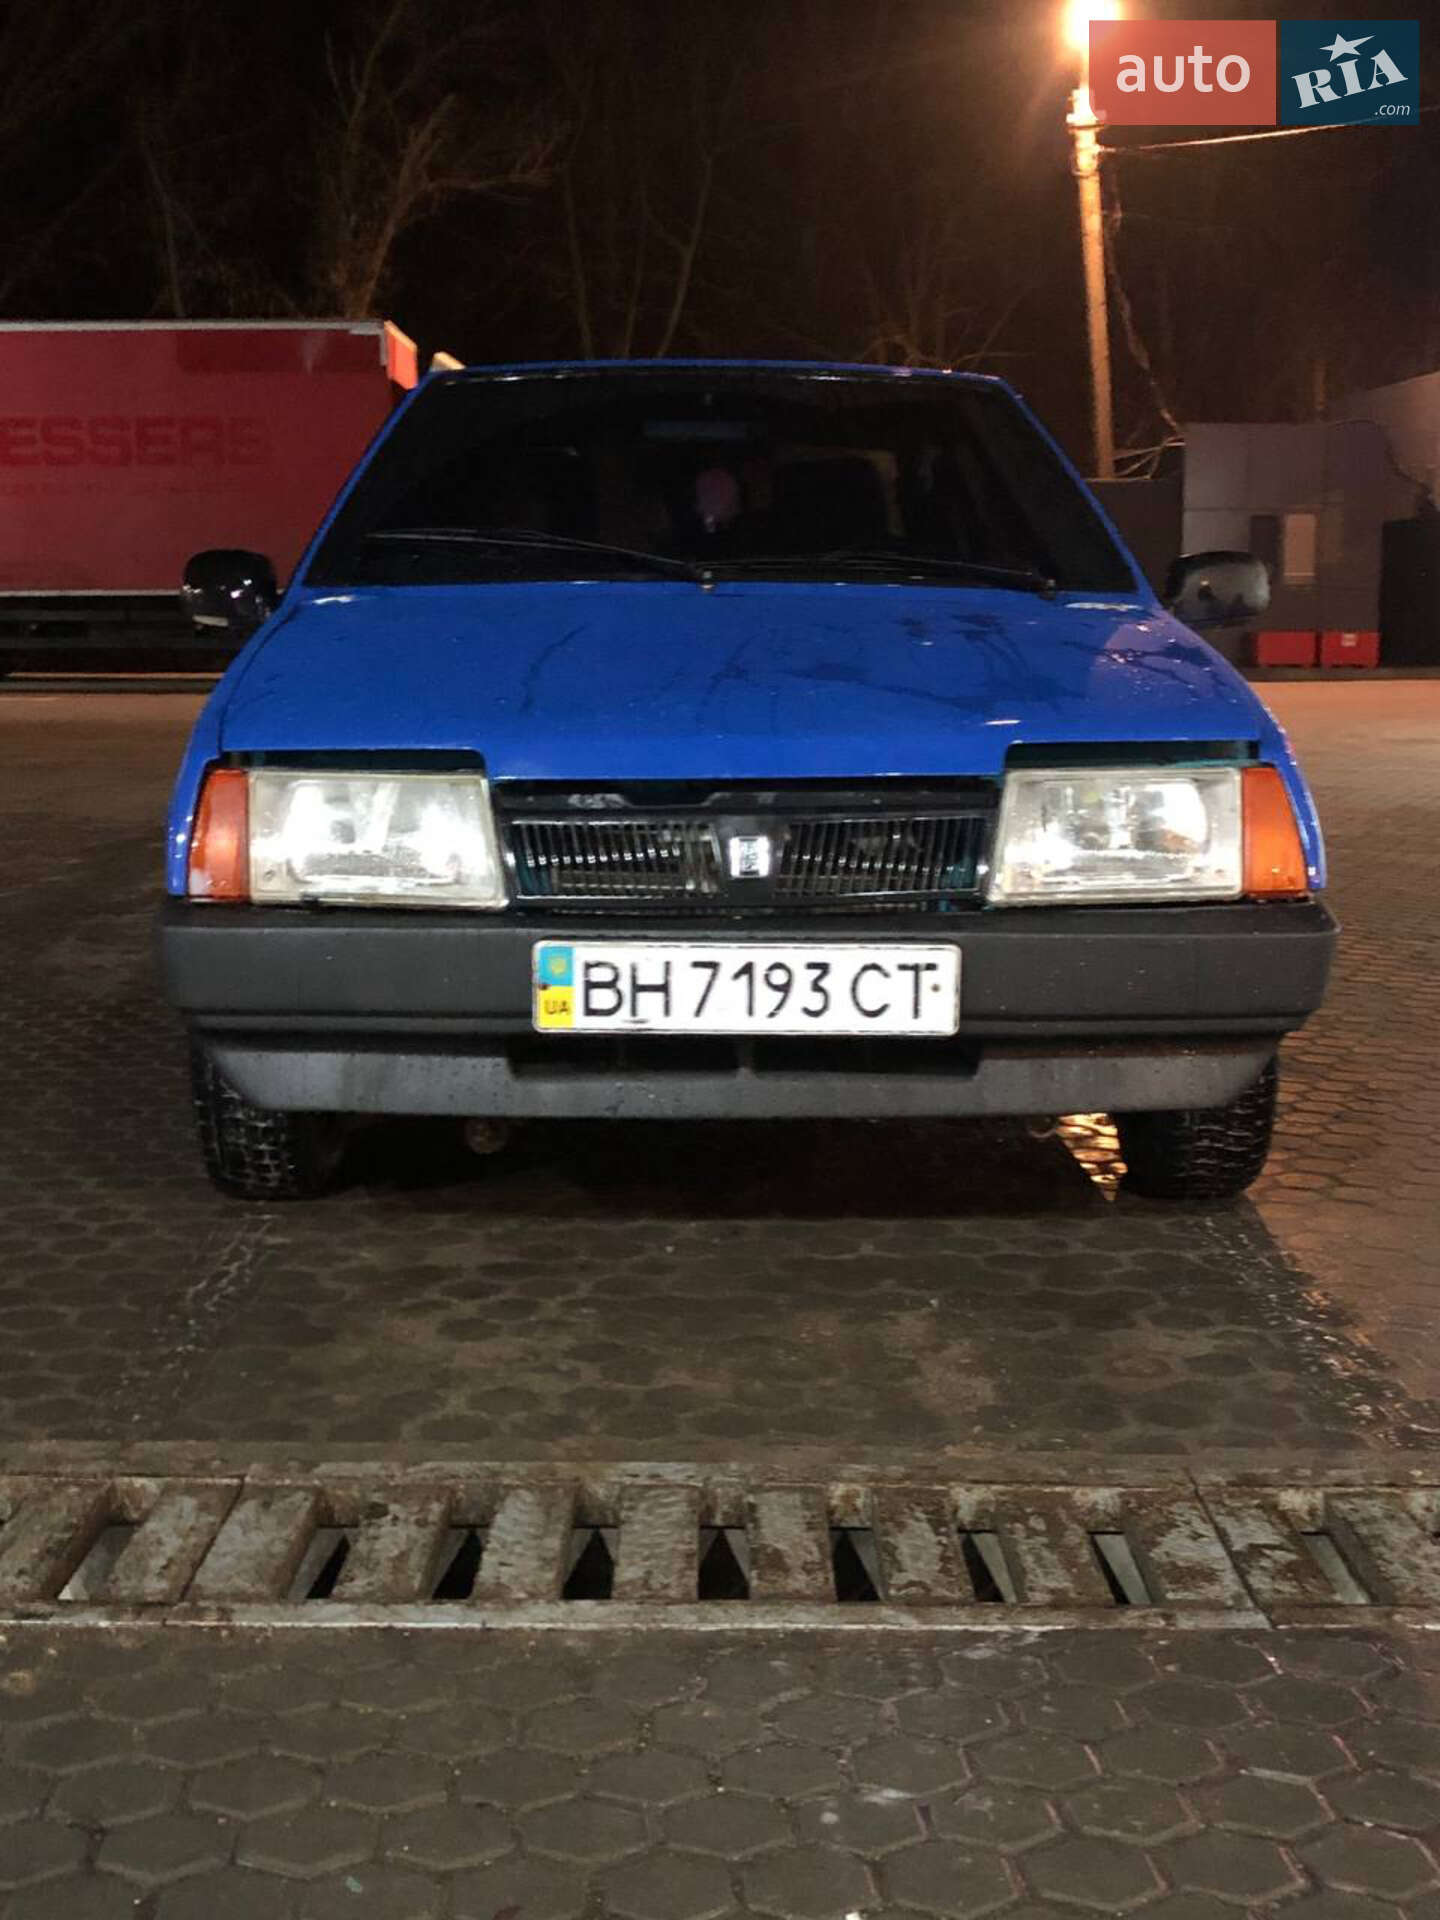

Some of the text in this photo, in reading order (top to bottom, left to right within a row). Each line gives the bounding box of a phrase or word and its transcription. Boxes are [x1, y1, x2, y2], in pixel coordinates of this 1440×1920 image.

[544, 1000, 571, 1015] UA
[583, 960, 938, 1019] BH 7193 CT
